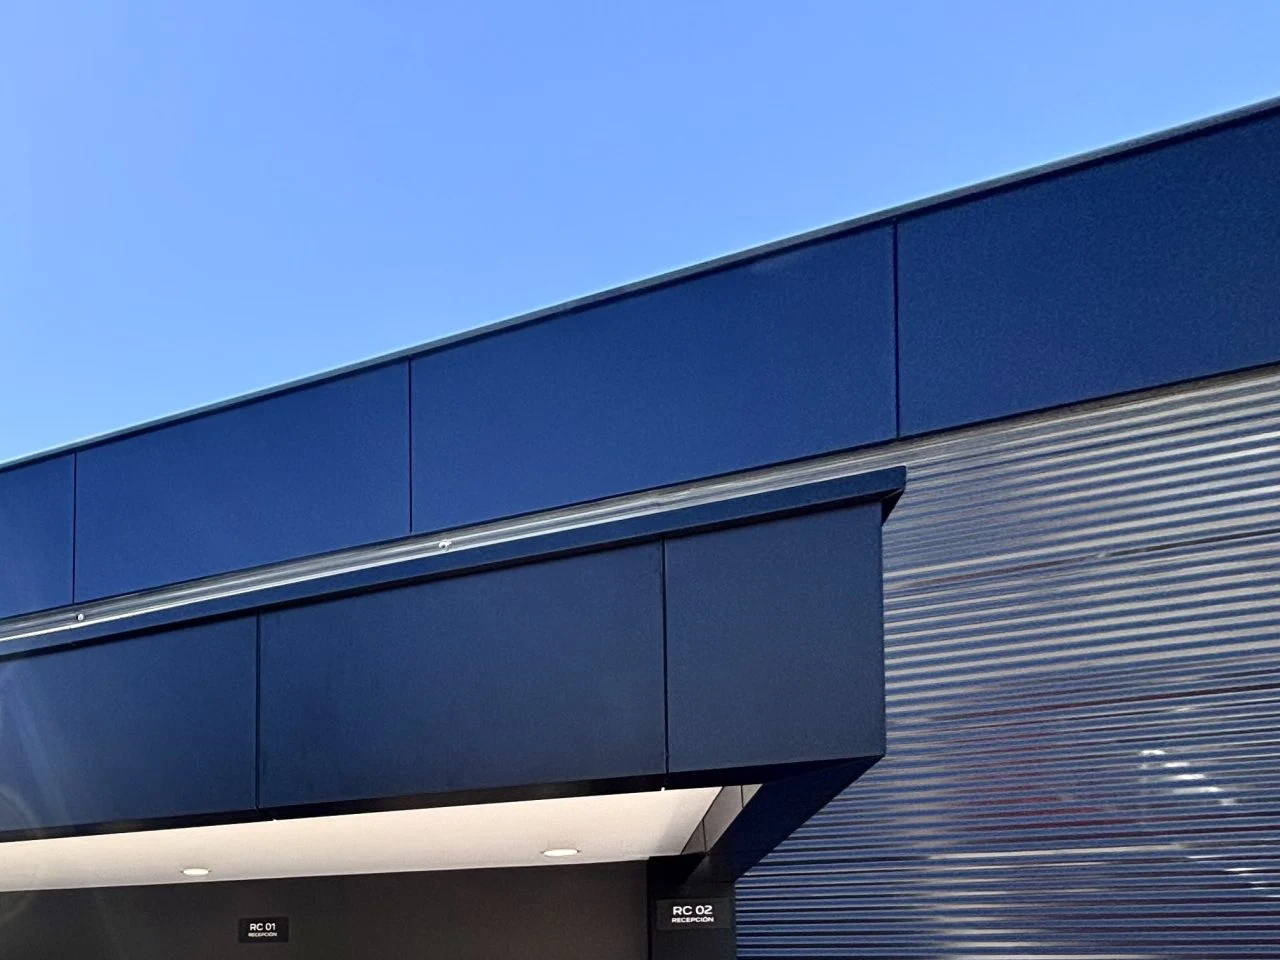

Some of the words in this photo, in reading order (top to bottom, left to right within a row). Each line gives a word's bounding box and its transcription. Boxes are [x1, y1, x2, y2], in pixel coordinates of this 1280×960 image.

[672, 905, 693, 916] RC
[695, 904, 713, 915] 02
[249, 922, 264, 931] RC
[265, 922, 276, 931] 01
